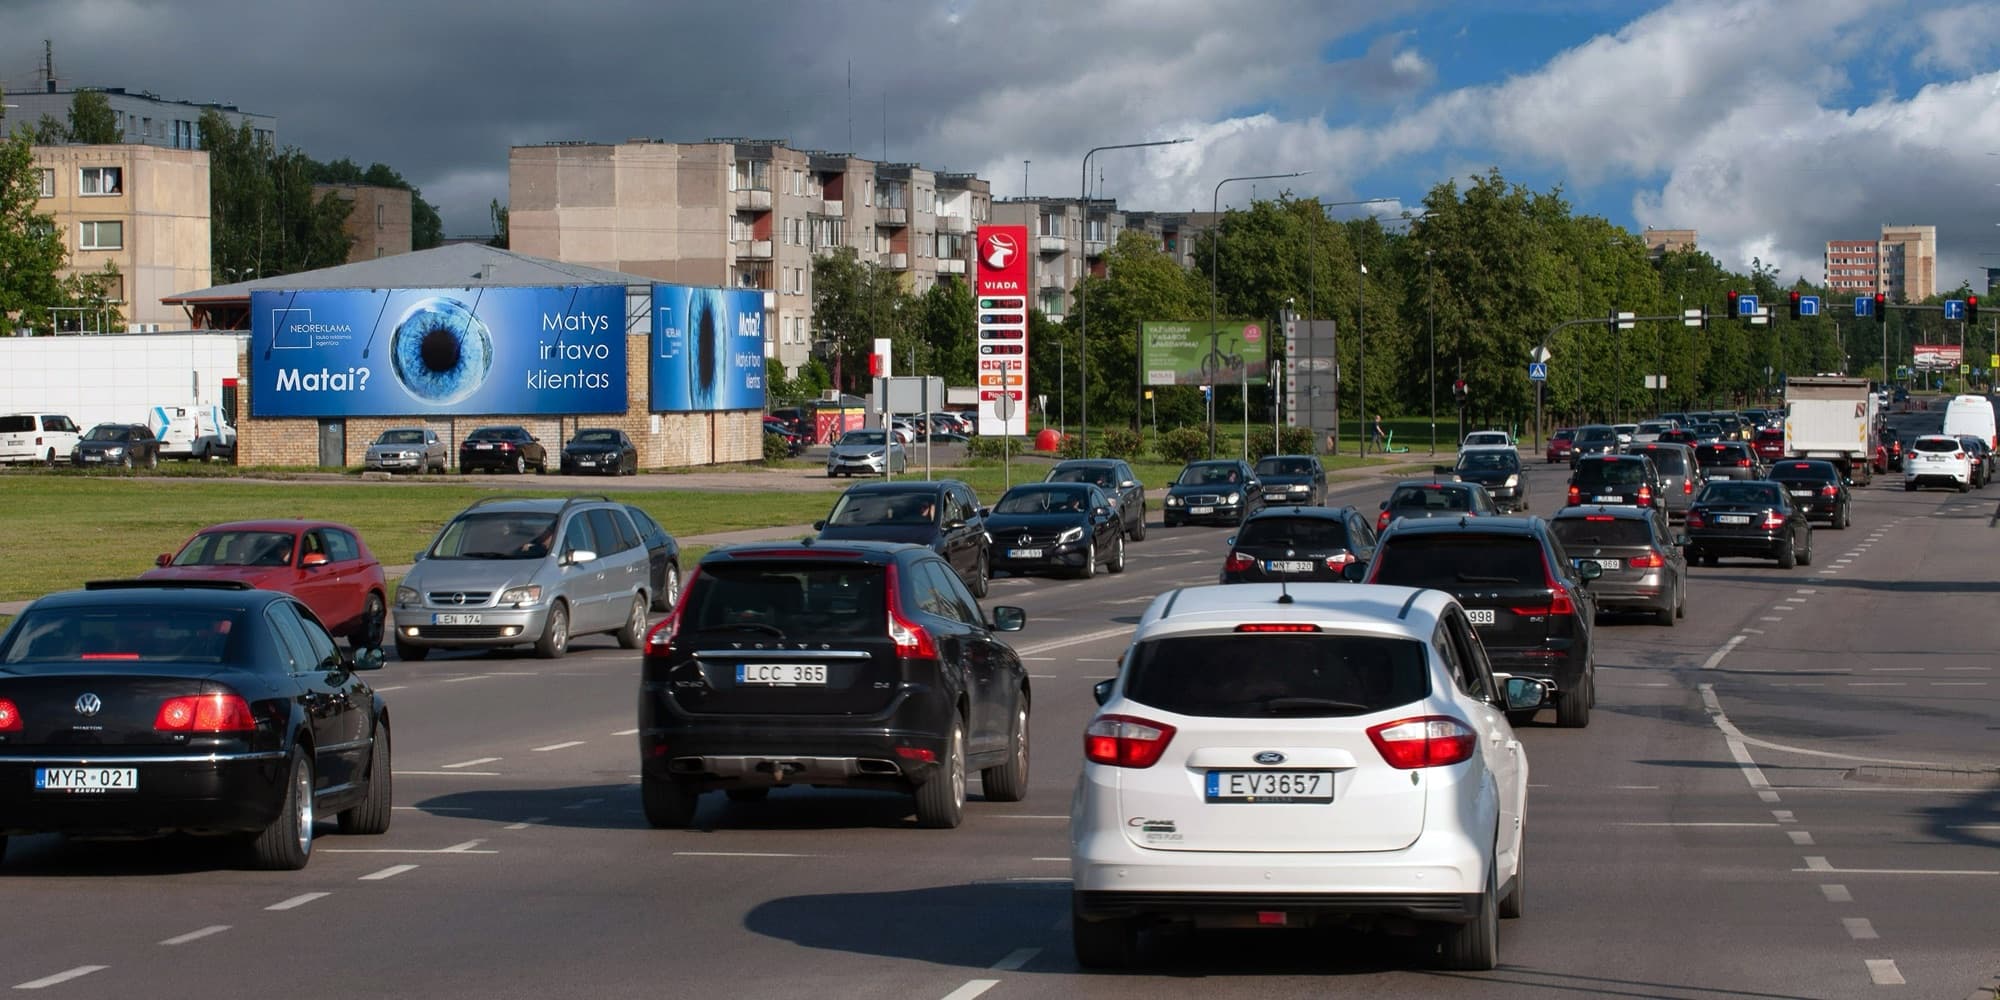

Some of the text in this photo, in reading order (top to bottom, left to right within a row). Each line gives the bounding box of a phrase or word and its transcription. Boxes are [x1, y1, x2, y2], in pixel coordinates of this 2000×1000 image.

[984, 281, 1018, 289] VIADA
[290, 324, 352, 333] NEOREKLAMA
[542, 311, 609, 335] Matys
[738, 311, 761, 337] Matai?
[540, 340, 609, 360] ir tavo
[275, 367, 371, 392] Matai?
[527, 369, 609, 389] klientas
[437, 615, 480, 624] LEN 174
[1470, 611, 1493, 622] 998
[746, 666, 782, 681] LCC
[793, 666, 824, 681] 365
[47, 770, 87, 787] MYR
[100, 770, 133, 787] 021
[1230, 774, 1321, 795] EV3657
